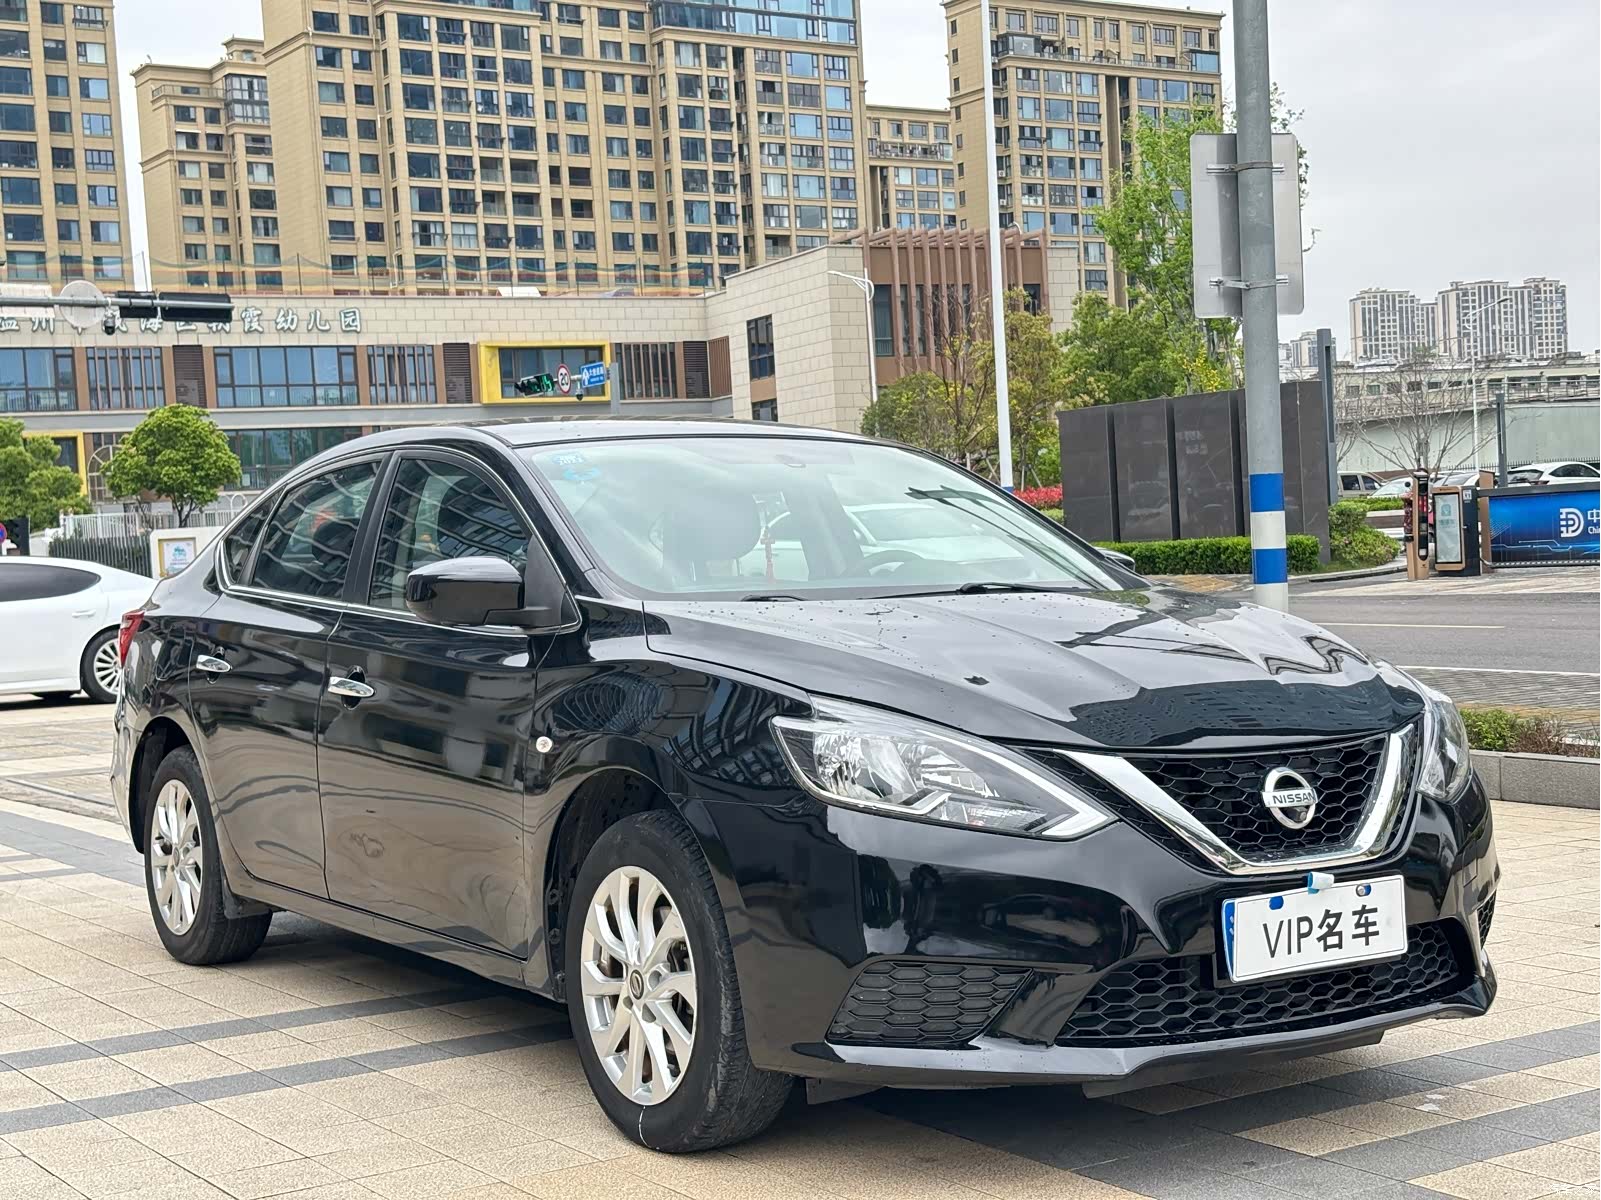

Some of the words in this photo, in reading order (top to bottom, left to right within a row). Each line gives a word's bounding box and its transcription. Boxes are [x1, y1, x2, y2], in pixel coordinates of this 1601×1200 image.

[560, 372, 569, 386] 20
[1272, 792, 1316, 804] NISSAN
[1262, 904, 1380, 959] VIP名车
